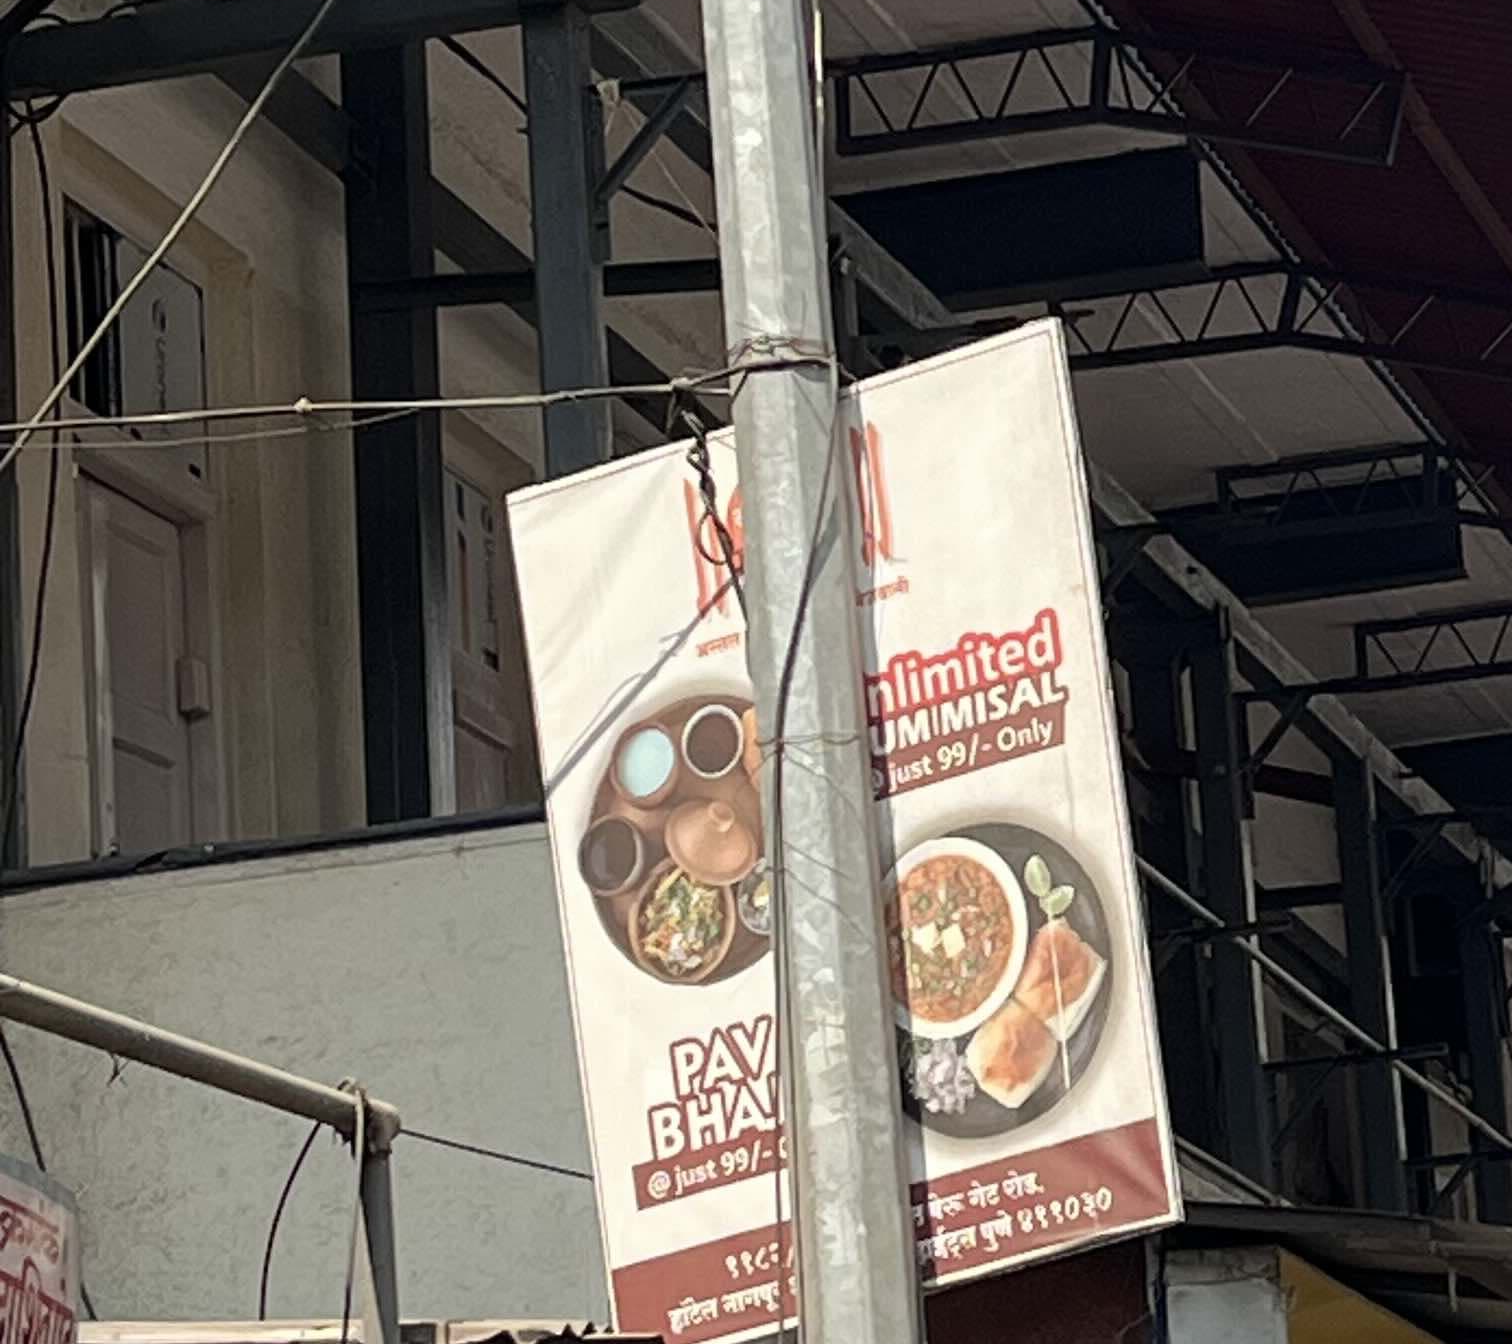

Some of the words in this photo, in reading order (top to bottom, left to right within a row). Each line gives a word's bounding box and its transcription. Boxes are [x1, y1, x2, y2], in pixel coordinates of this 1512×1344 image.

[866, 612, 1060, 719] nlimited
[888, 756, 933, 793] just
[997, 716, 1053, 752] Only
[670, 1014, 773, 1101] PAV
[674, 1158, 718, 1196] just
